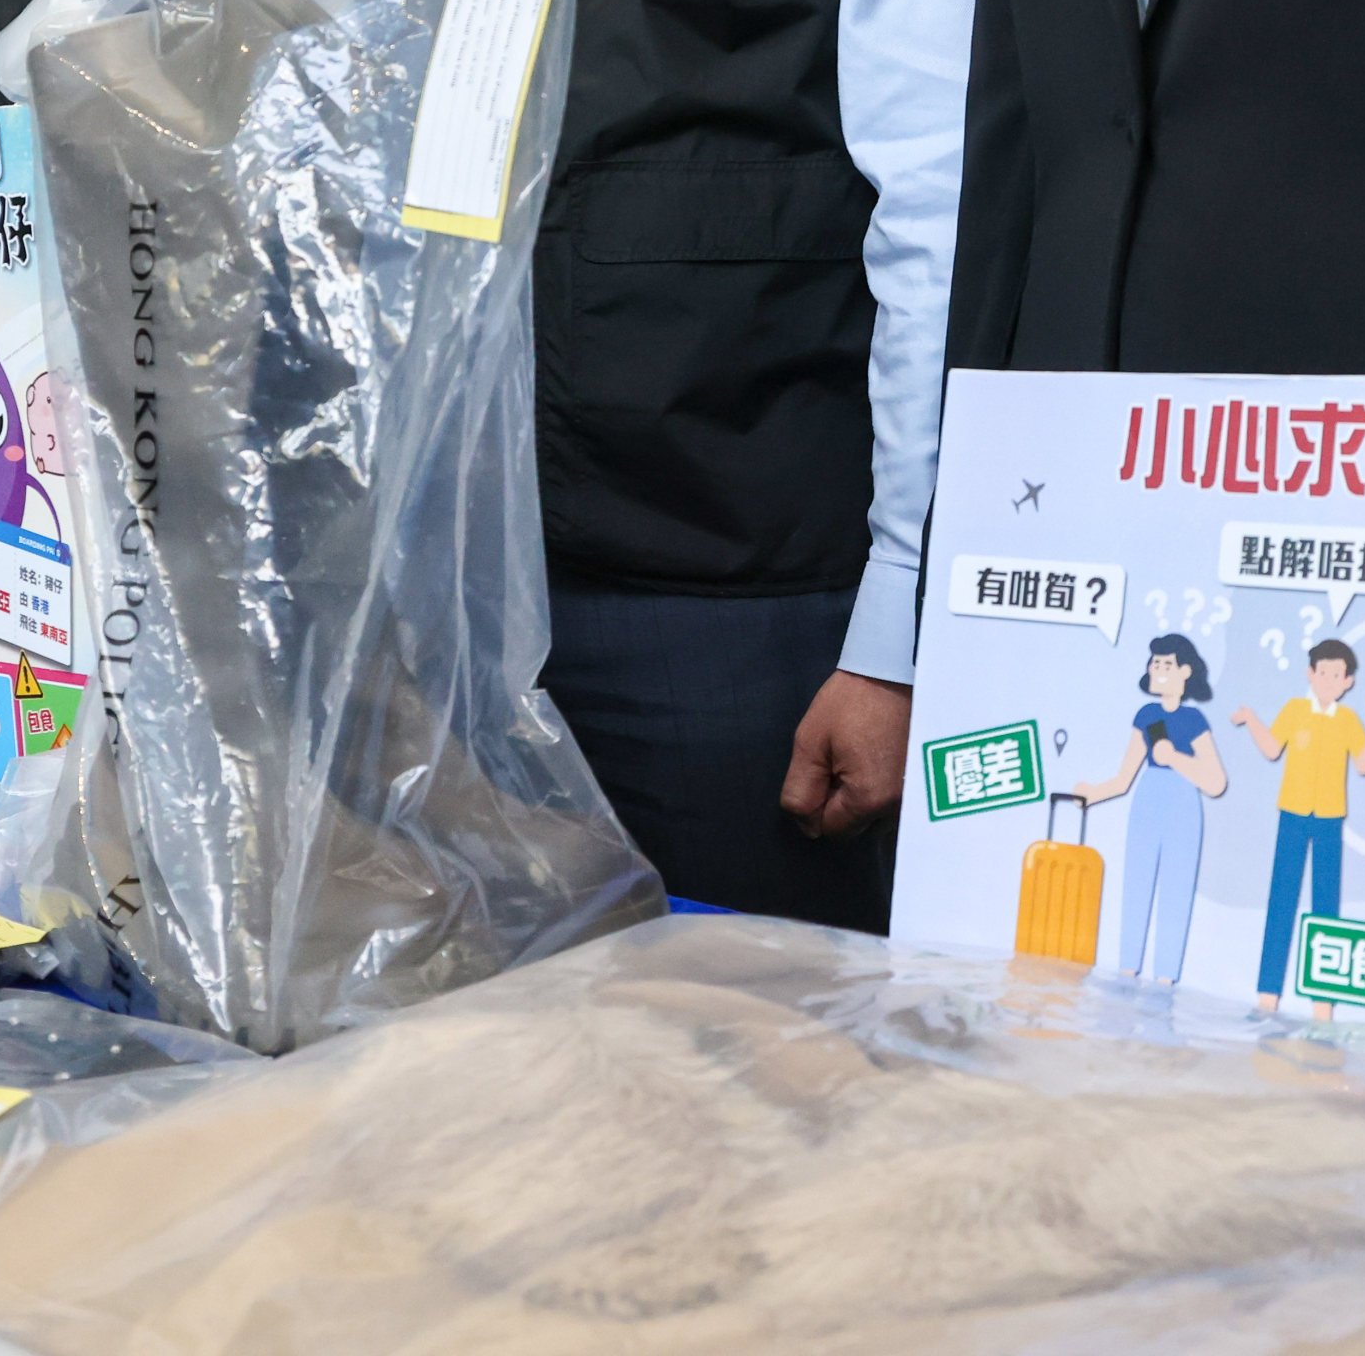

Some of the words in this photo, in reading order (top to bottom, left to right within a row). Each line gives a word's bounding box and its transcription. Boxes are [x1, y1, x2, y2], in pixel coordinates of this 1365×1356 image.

[129, 200, 157, 369] HONG
[120, 387, 159, 557] KONG
[31, 595, 50, 616] 香港
[976, 567, 1108, 615] 有咁筍？
[40, 621, 68, 646] 東南亞
[943, 737, 1023, 805] 優差
